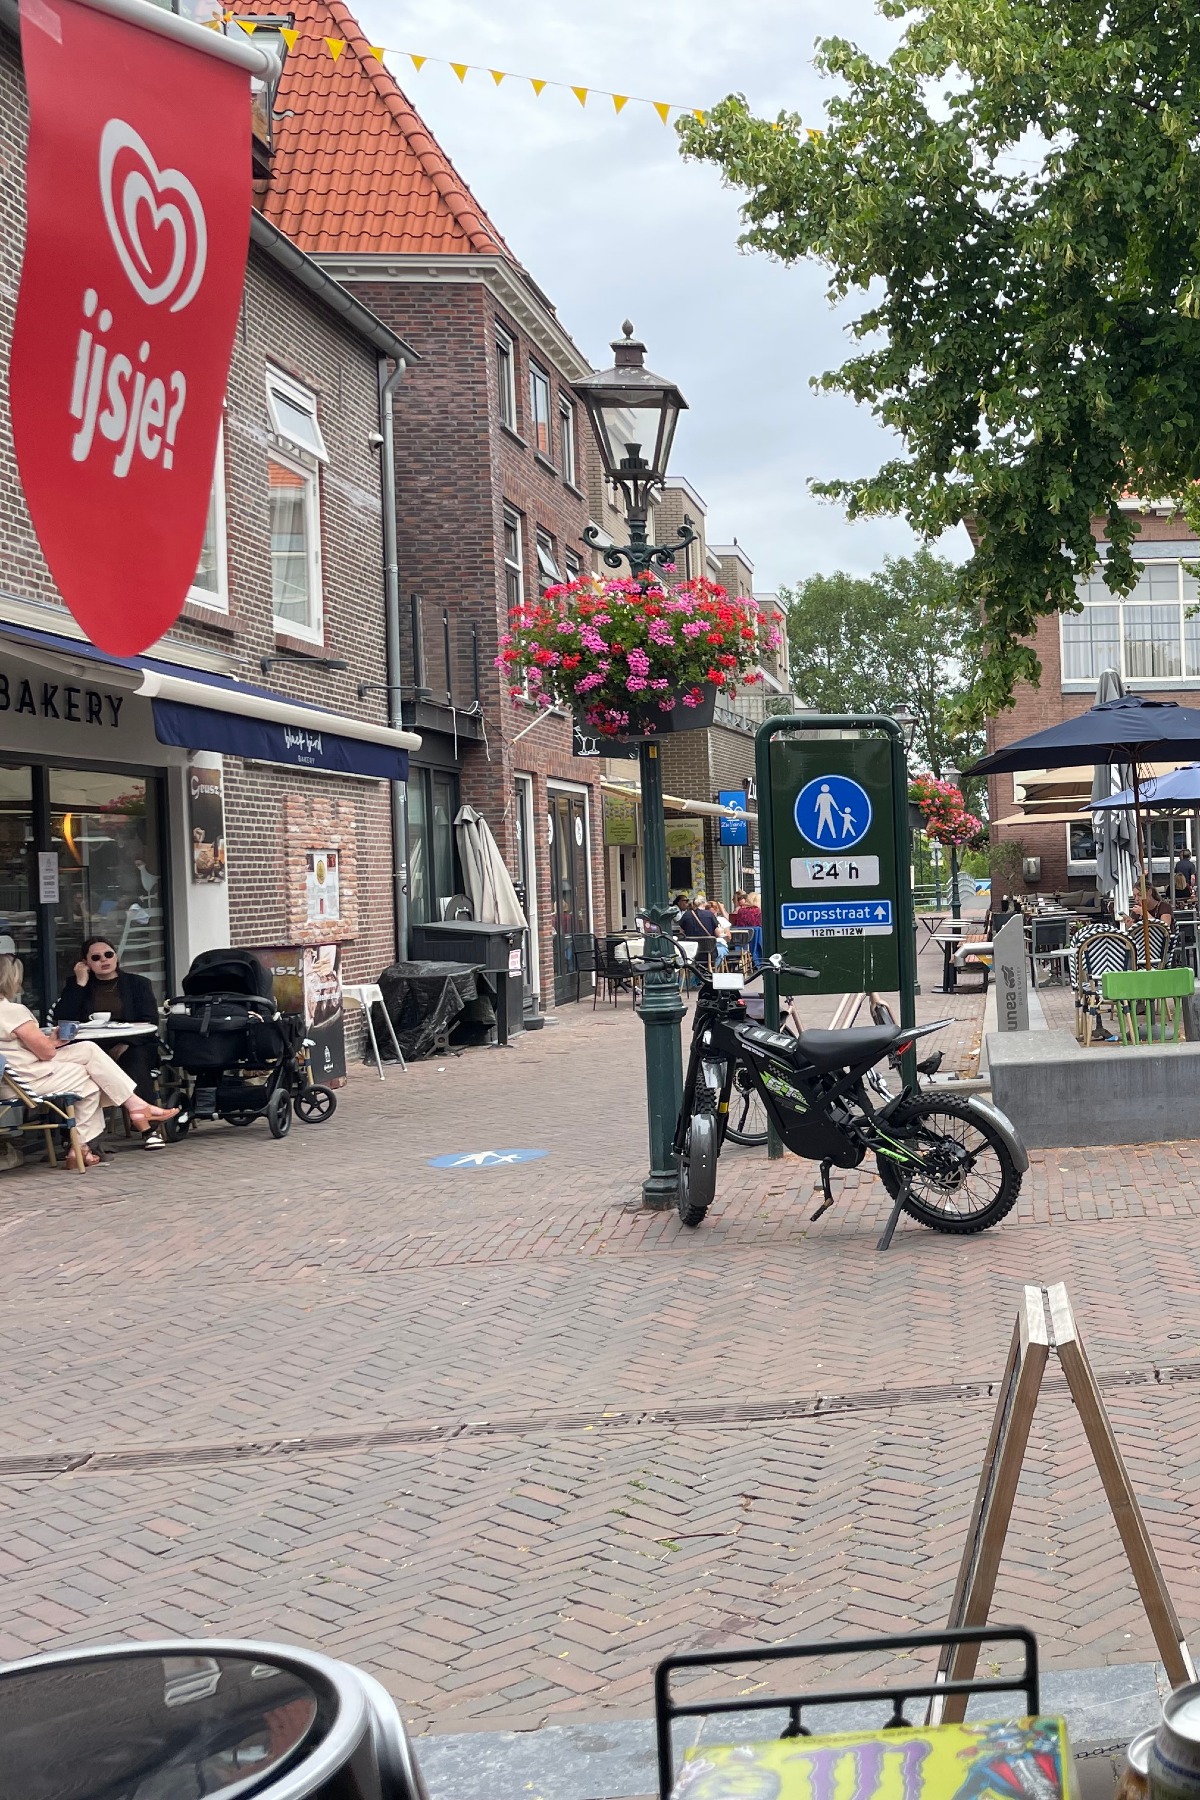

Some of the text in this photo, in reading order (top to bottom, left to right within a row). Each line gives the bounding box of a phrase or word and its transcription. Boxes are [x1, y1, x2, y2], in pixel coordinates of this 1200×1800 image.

[69, 288, 187, 478] ijsje?
[0, 673, 124, 727] BAKERY
[306, 731, 323, 755] bird
[812, 863, 839, 880] 24
[848, 862, 859, 879] h
[788, 907, 871, 922] Dorpsstraat
[1005, 991, 1018, 1031] unea
